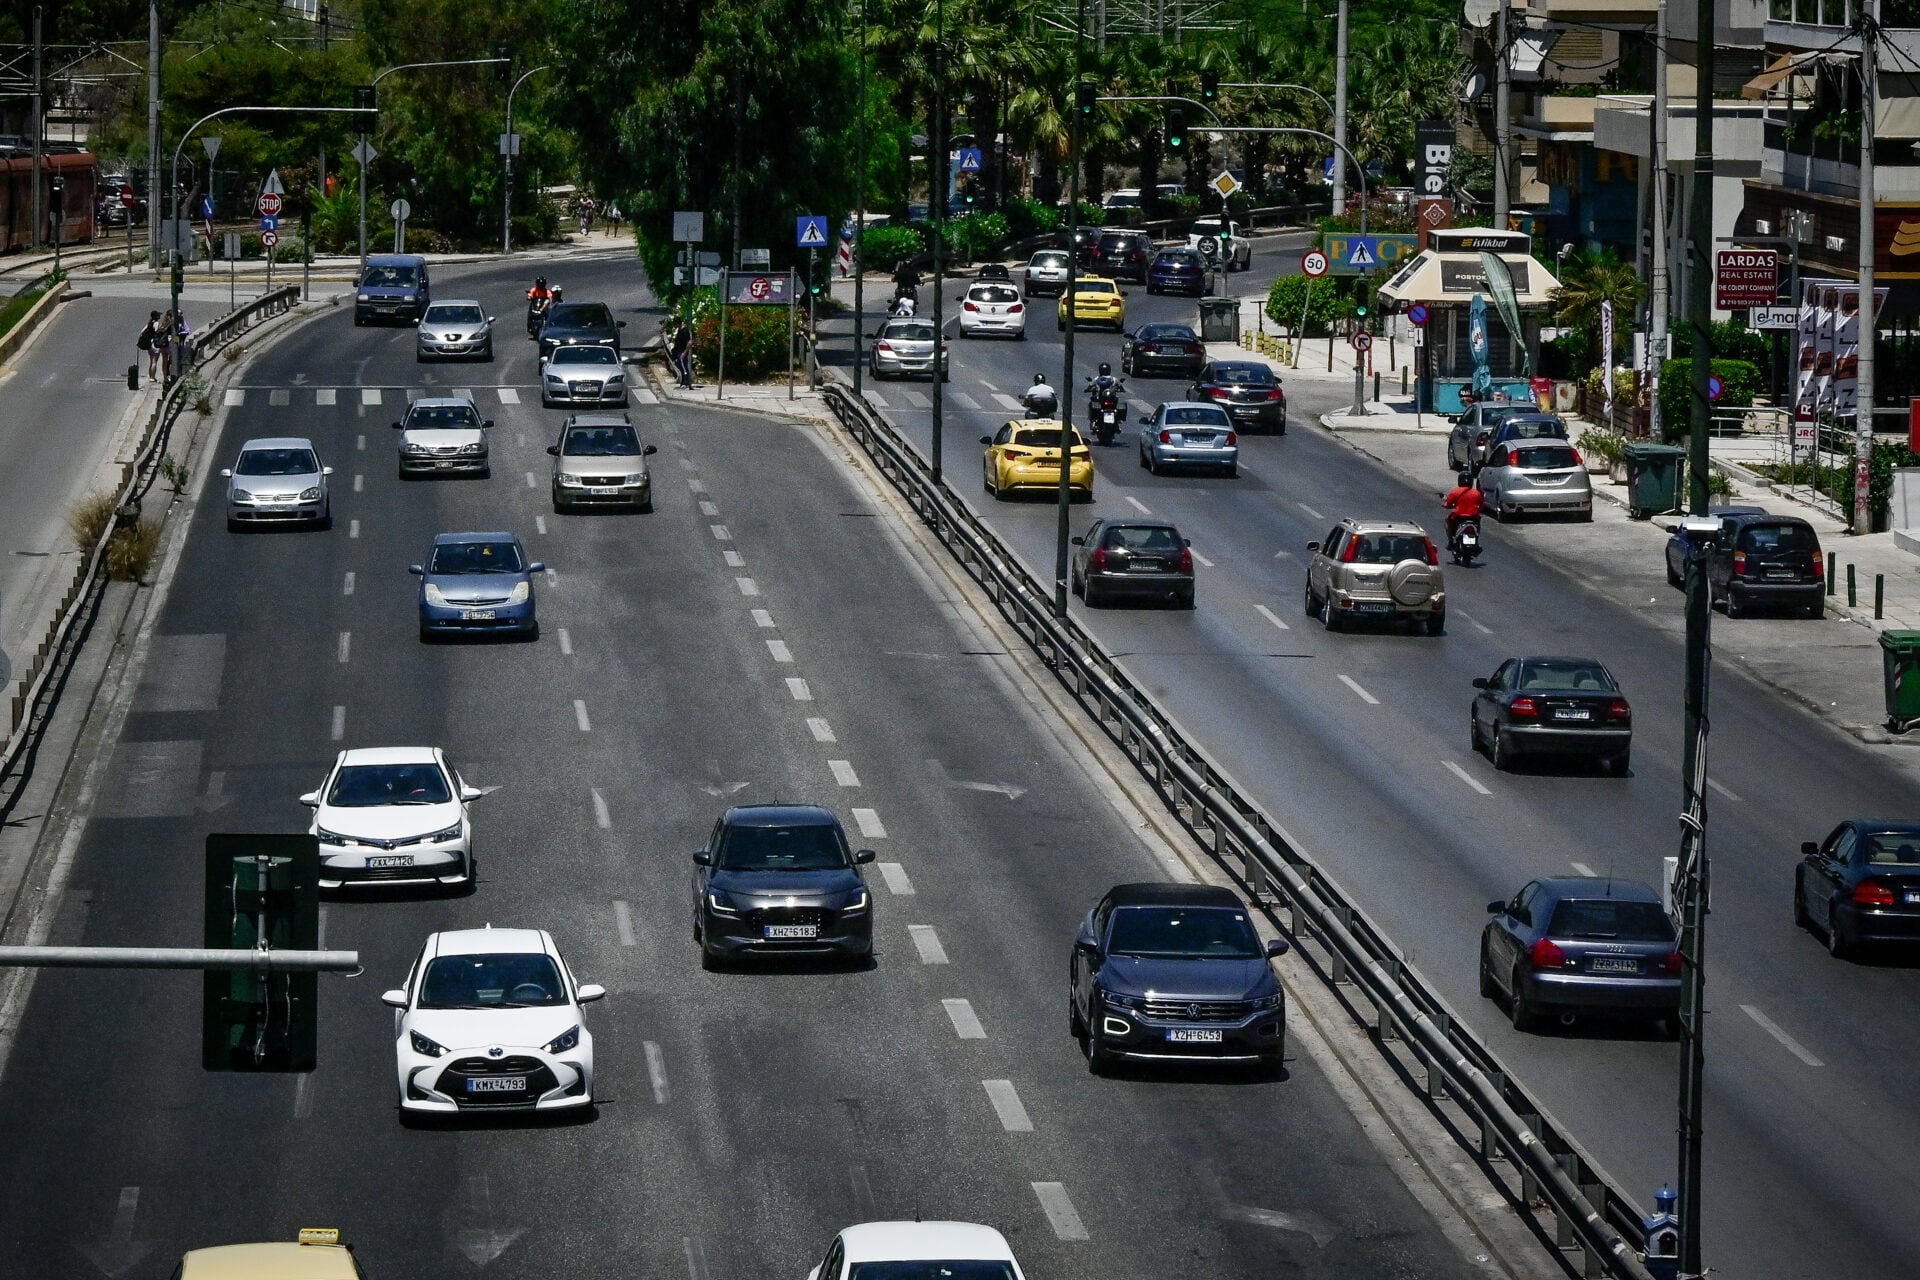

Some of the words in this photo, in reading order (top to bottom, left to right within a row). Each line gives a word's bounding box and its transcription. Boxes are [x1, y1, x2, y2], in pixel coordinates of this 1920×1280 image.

[261, 198, 279, 210] STOP
[1473, 238, 1508, 248] istikbal
[1306, 258, 1323, 270] 50
[1720, 255, 1774, 267] LARDAS
[1720, 271, 1741, 279] REAL
[1743, 271, 1773, 279] ESTATE
